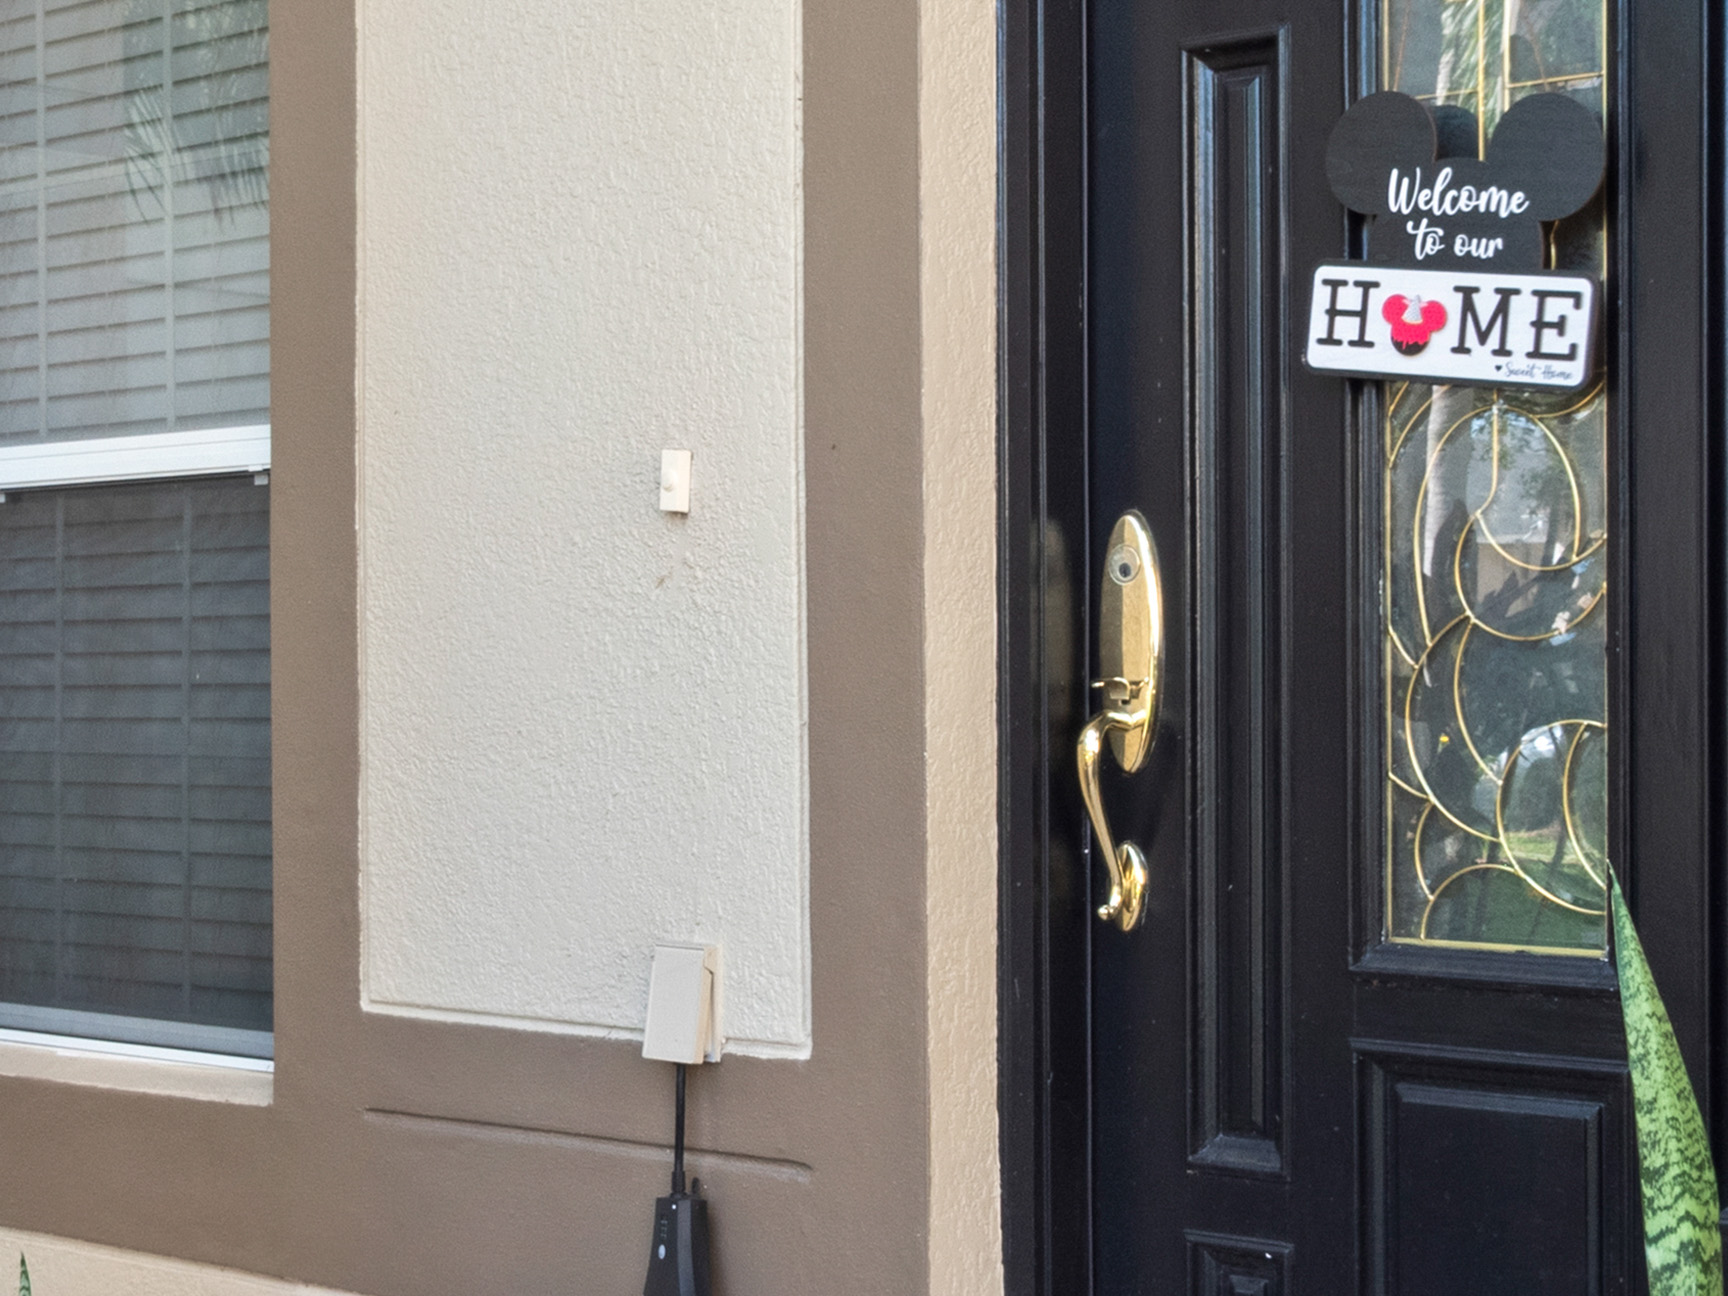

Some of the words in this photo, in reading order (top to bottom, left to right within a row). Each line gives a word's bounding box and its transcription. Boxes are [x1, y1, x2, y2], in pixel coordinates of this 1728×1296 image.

[1388, 167, 1530, 218] Welcome
[1406, 218, 1445, 260] to
[1454, 234, 1504, 259] our
[1316, 278, 1582, 361] HME
